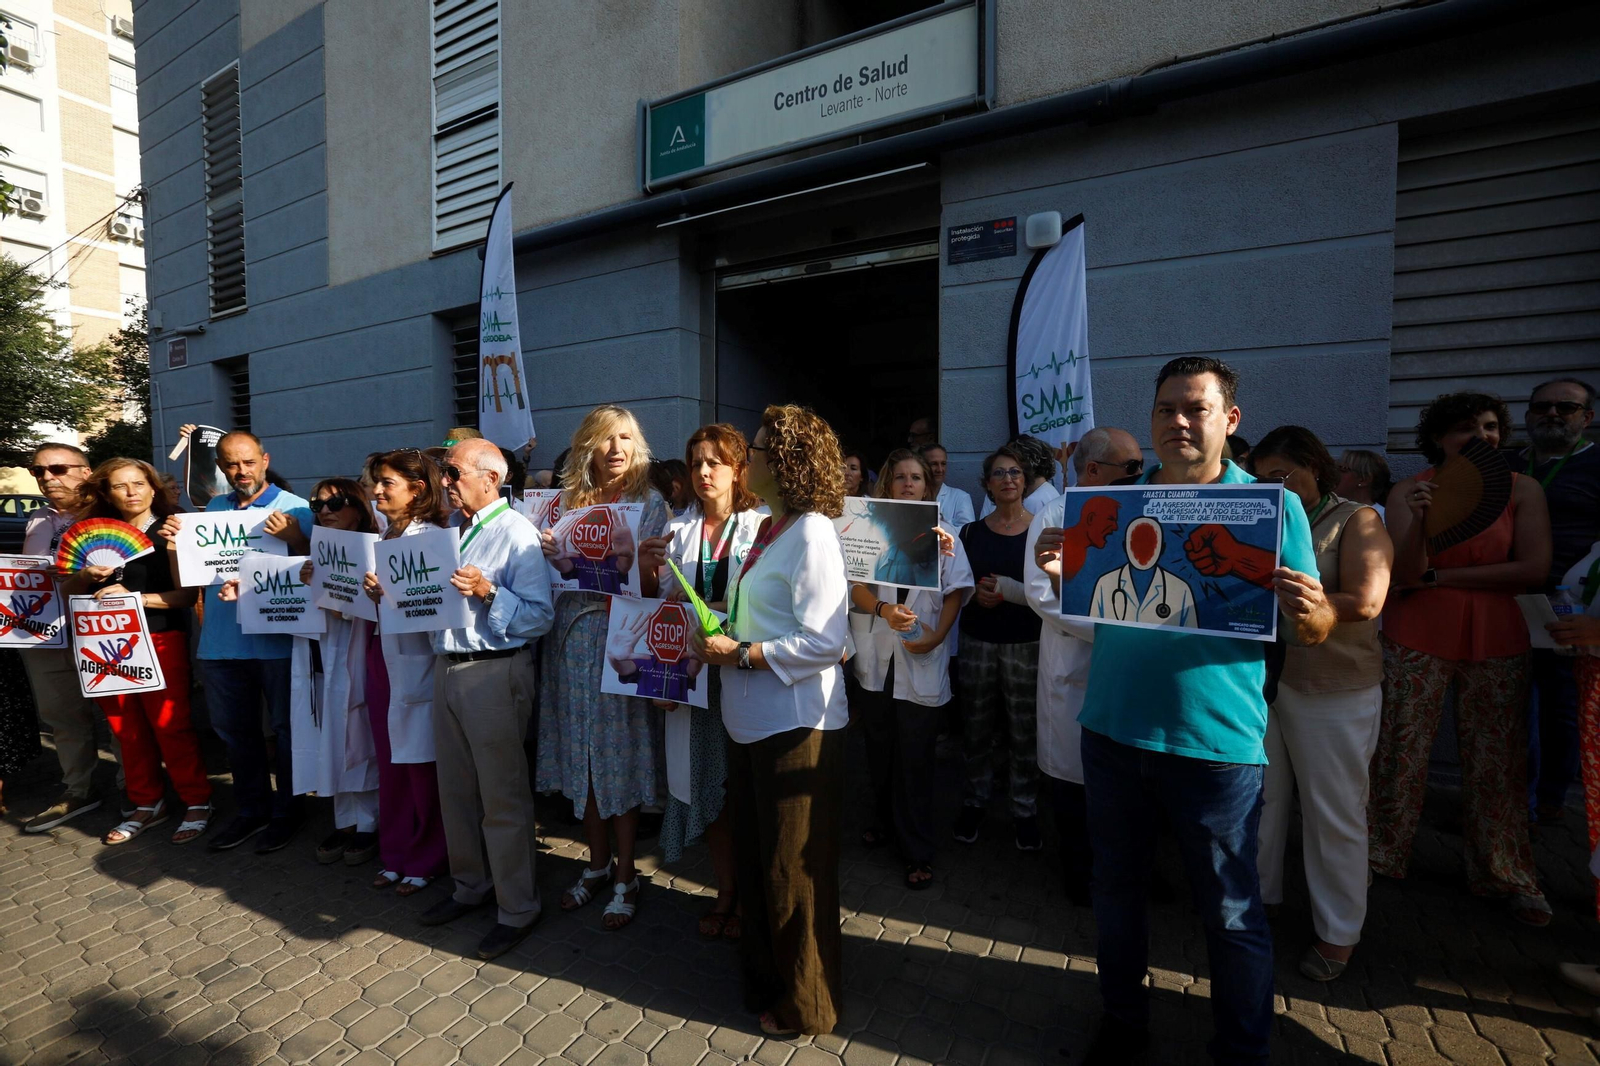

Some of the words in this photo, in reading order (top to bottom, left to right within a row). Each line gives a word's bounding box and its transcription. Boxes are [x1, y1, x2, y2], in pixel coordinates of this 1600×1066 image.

[774, 91, 828, 111] Centro
[833, 73, 853, 94] de
[859, 54, 908, 86] Salud
[820, 94, 863, 118] Levante
[875, 82, 908, 102] Norte
[951, 225, 984, 236] Instalación
[951, 233, 981, 244] protegida
[482, 310, 512, 333] SMA
[1021, 382, 1083, 420] SMA
[1029, 413, 1085, 434] CÓRDOBA
[195, 522, 262, 548] SMA
[575, 524, 607, 542] STOP
[578, 542, 606, 550] AGRESIONES
[204, 559, 239, 567] SINDICATO
[318, 541, 357, 573] SMA
[389, 549, 440, 586] SMA
[847, 555, 869, 568] SMA
[0, 572, 45, 589] TOP
[253, 568, 305, 597] SMA
[10, 594, 45, 618] NO
[286, 605, 306, 613] MÉDICO
[397, 599, 422, 609] SINDICATO
[423, 596, 443, 606] MÉDICO
[405, 610, 412, 618] DE
[412, 608, 437, 616] CÓRDOBA
[77, 613, 131, 634] STOP
[274, 613, 299, 622] CÓRDOBA
[653, 622, 683, 643] STOP
[98, 637, 134, 664] NO
[654, 642, 682, 652] AGRESIONES
[80, 659, 153, 680] AGRESIONES
